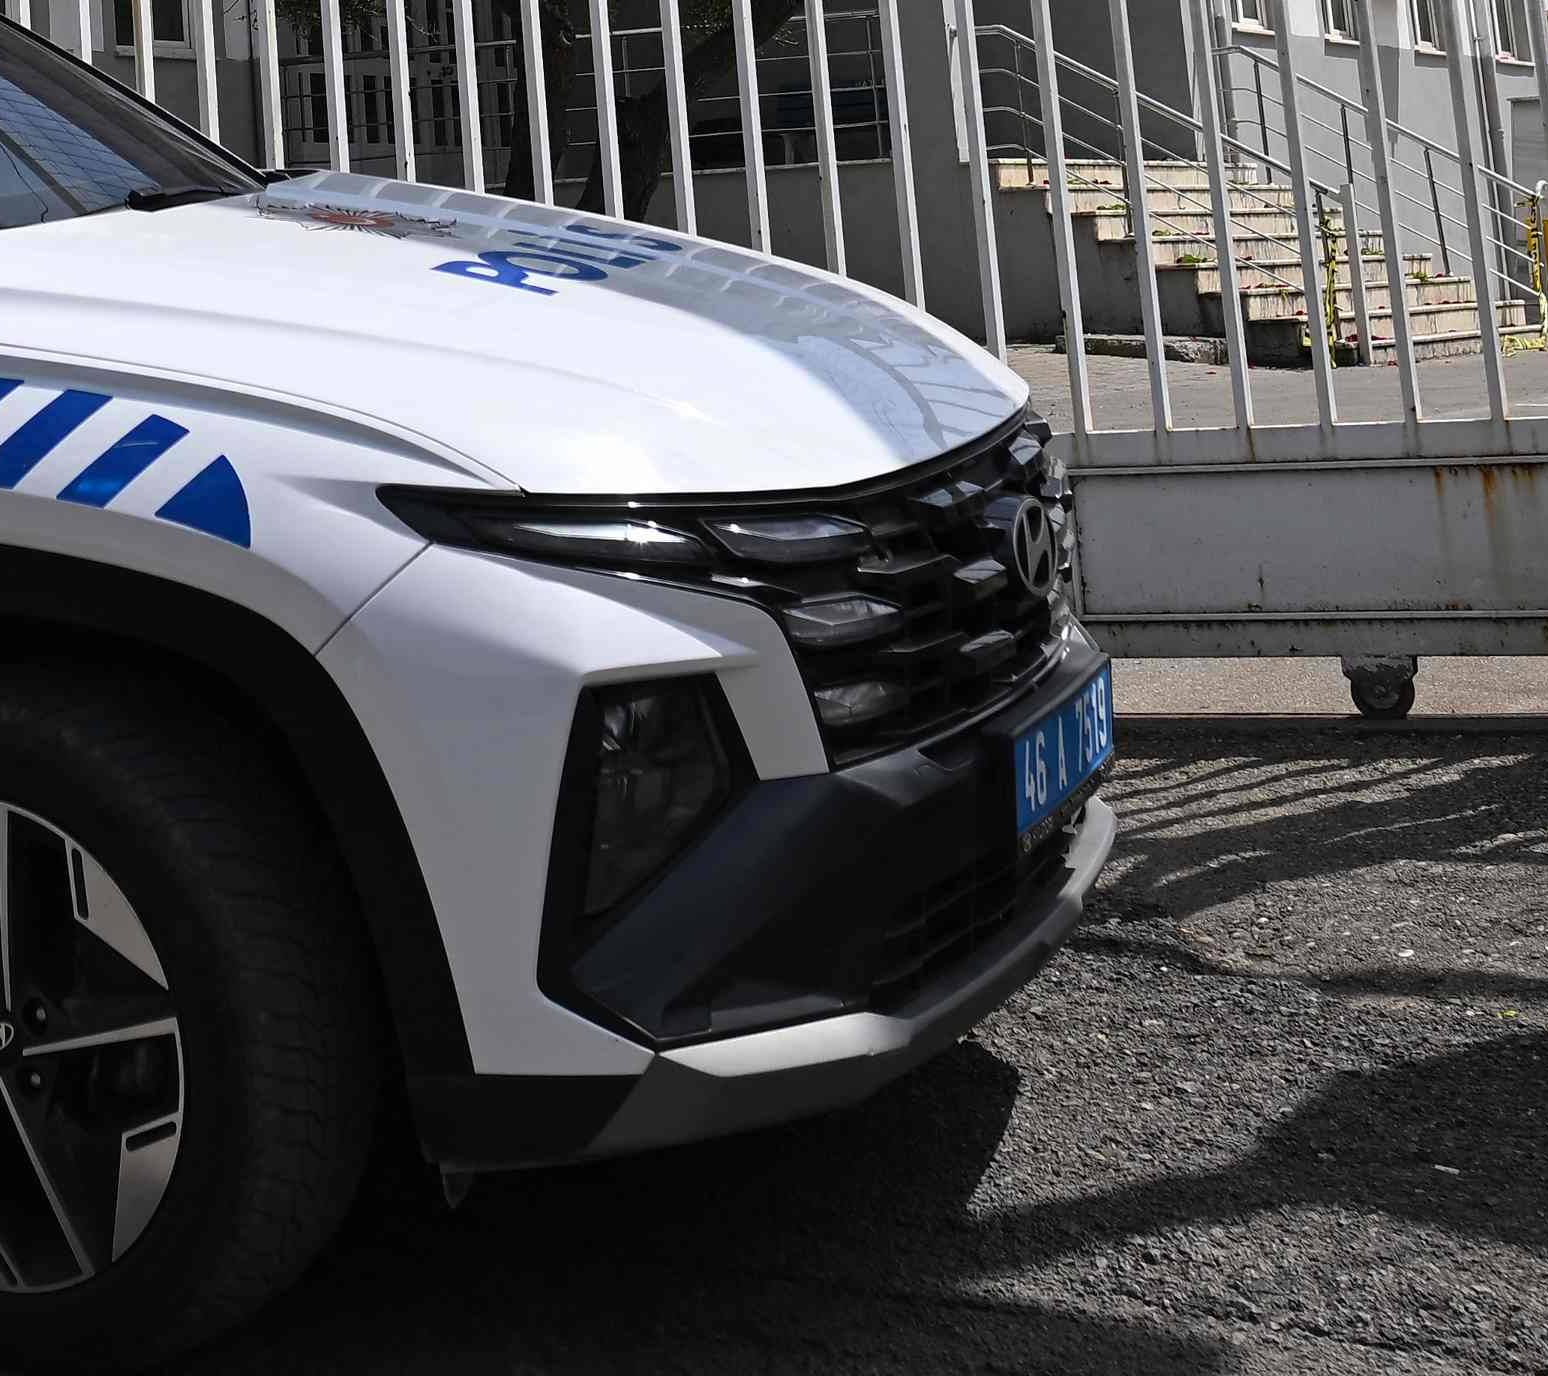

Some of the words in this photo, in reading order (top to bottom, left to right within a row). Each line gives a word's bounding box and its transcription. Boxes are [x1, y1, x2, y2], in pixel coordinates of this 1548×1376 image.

[1026, 730, 1048, 813] 46
[1058, 714, 1068, 792] A
[1075, 675, 1108, 774] 7519
